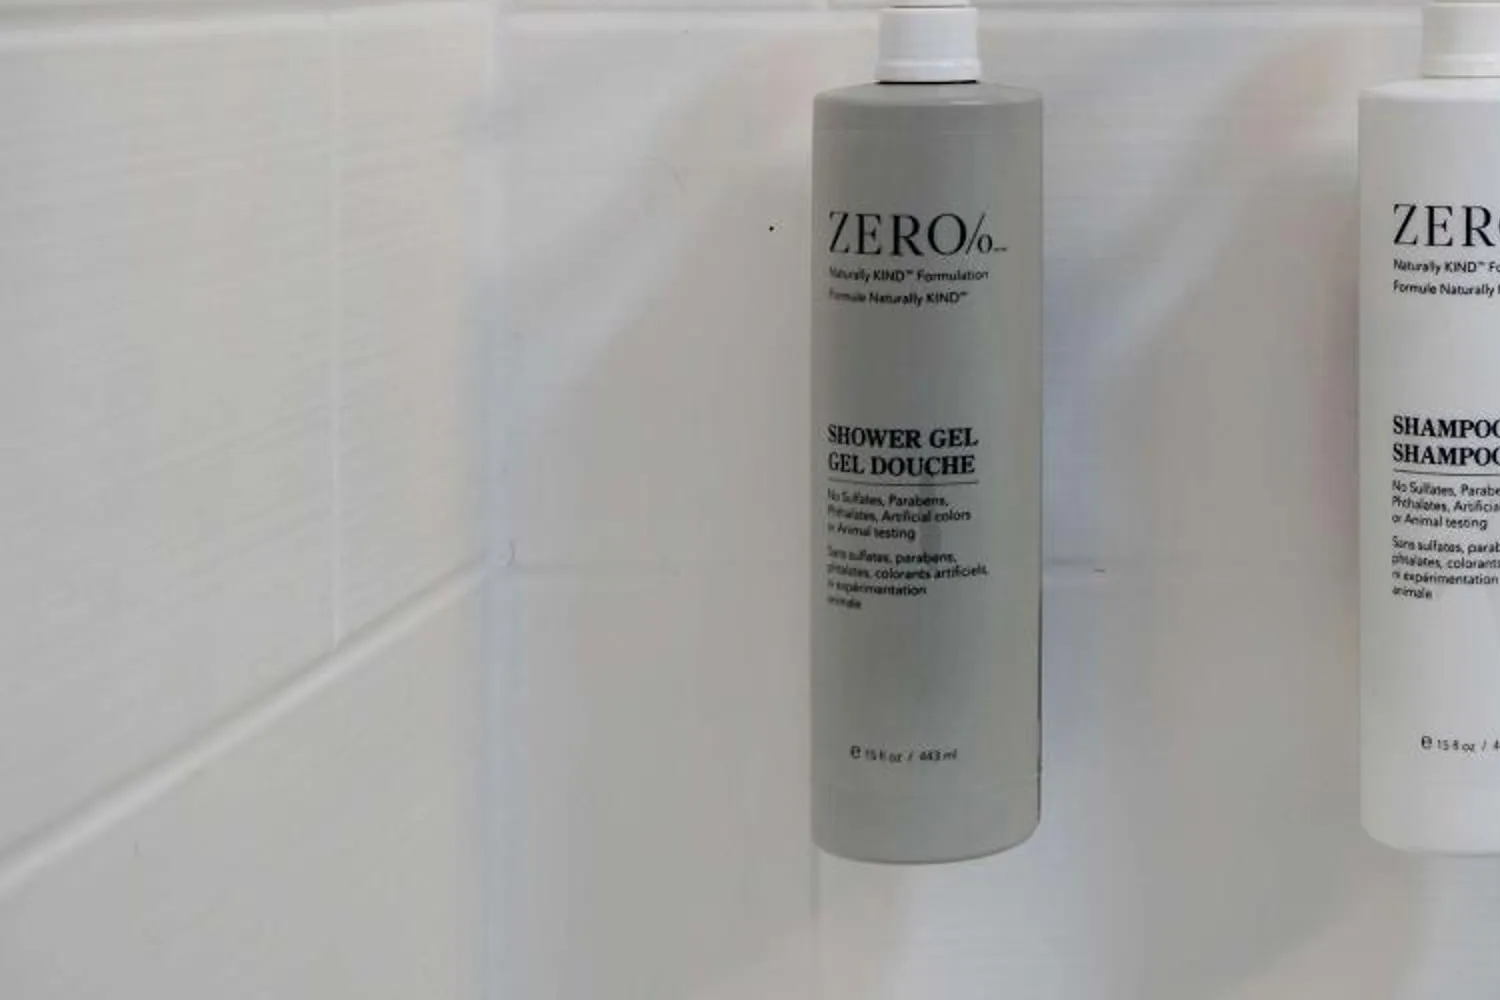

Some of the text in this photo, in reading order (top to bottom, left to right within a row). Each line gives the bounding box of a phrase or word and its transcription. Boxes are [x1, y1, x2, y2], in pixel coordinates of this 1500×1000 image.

[1393, 259, 1441, 275] Naturally
[917, 269, 989, 281] Formulation
[1393, 280, 1437, 295] Formule
[1440, 284, 1494, 297] Naturally
[869, 292, 923, 307] Naturally
[828, 423, 978, 449] SHOWER GEL
[828, 451, 975, 476] GEL DOUCHE
[1392, 480, 1406, 493] No
[935, 510, 971, 521] colors
[1404, 513, 1443, 527] Animal
[874, 527, 915, 542] testing
